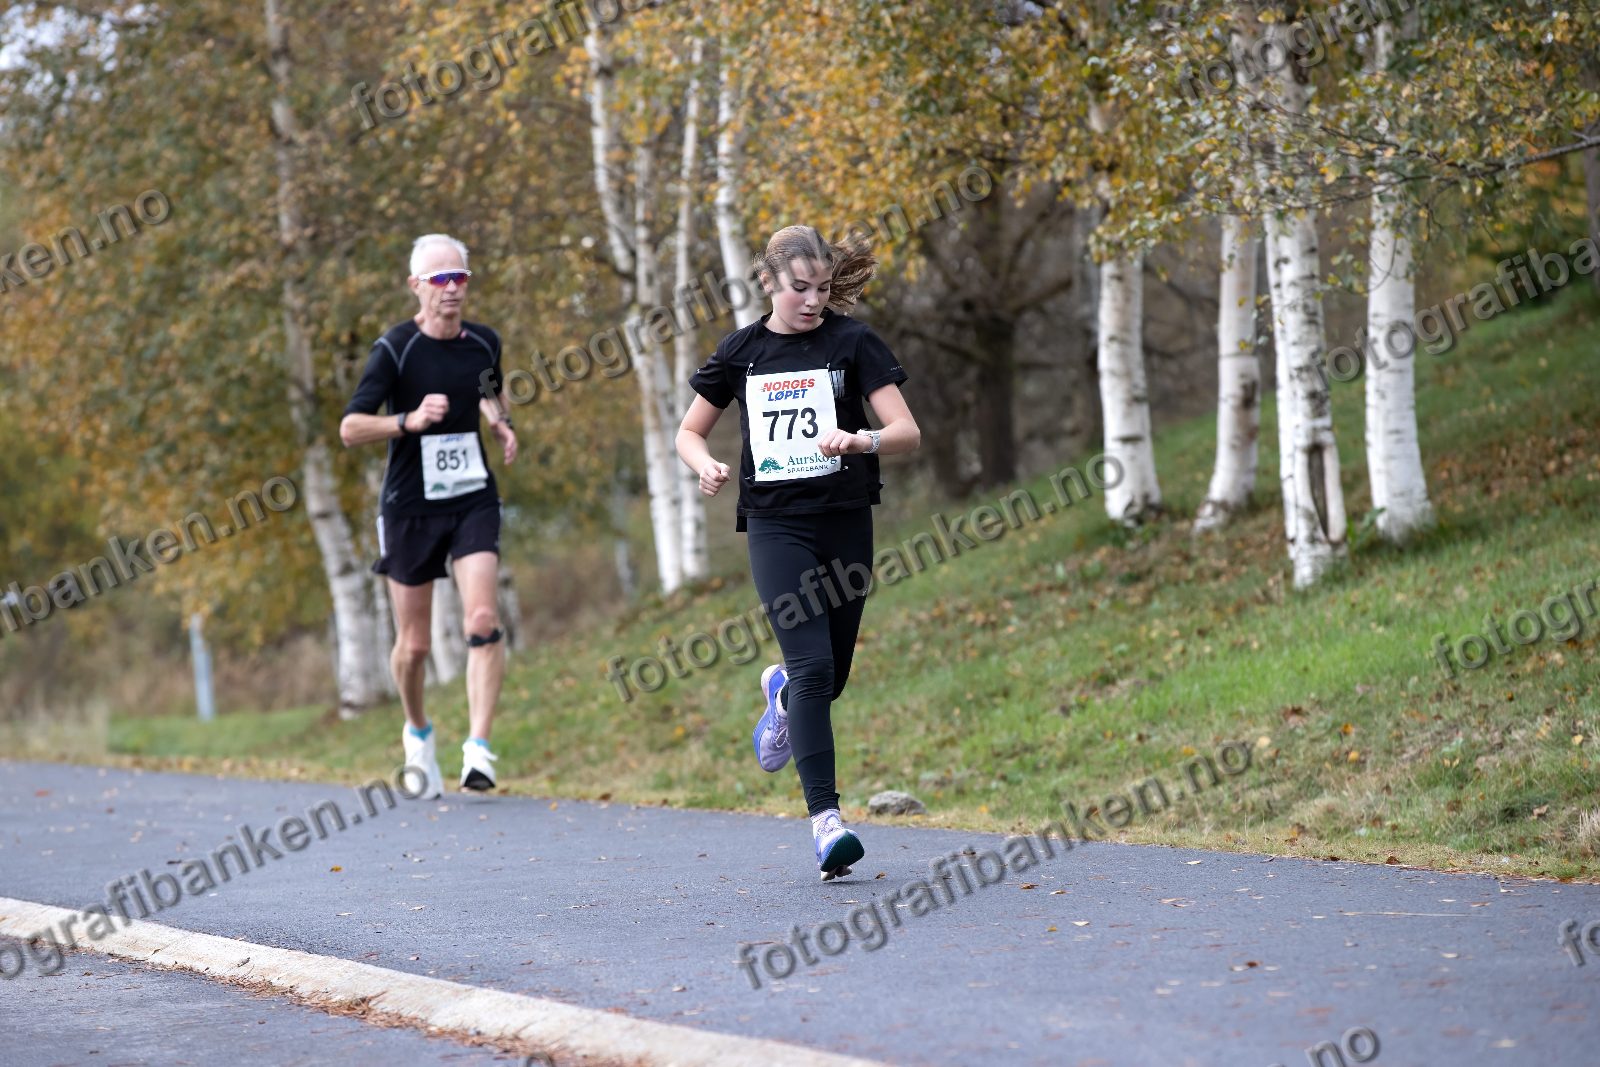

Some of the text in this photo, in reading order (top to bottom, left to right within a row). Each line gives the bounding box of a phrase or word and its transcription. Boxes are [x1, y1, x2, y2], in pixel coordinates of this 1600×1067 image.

[762, 378, 815, 392] NORGES
[768, 389, 808, 402] LØPET
[762, 407, 818, 441] 773
[437, 448, 469, 471] 851
[787, 452, 838, 466] Aurskog
[787, 464, 829, 474] SPAREBANK
